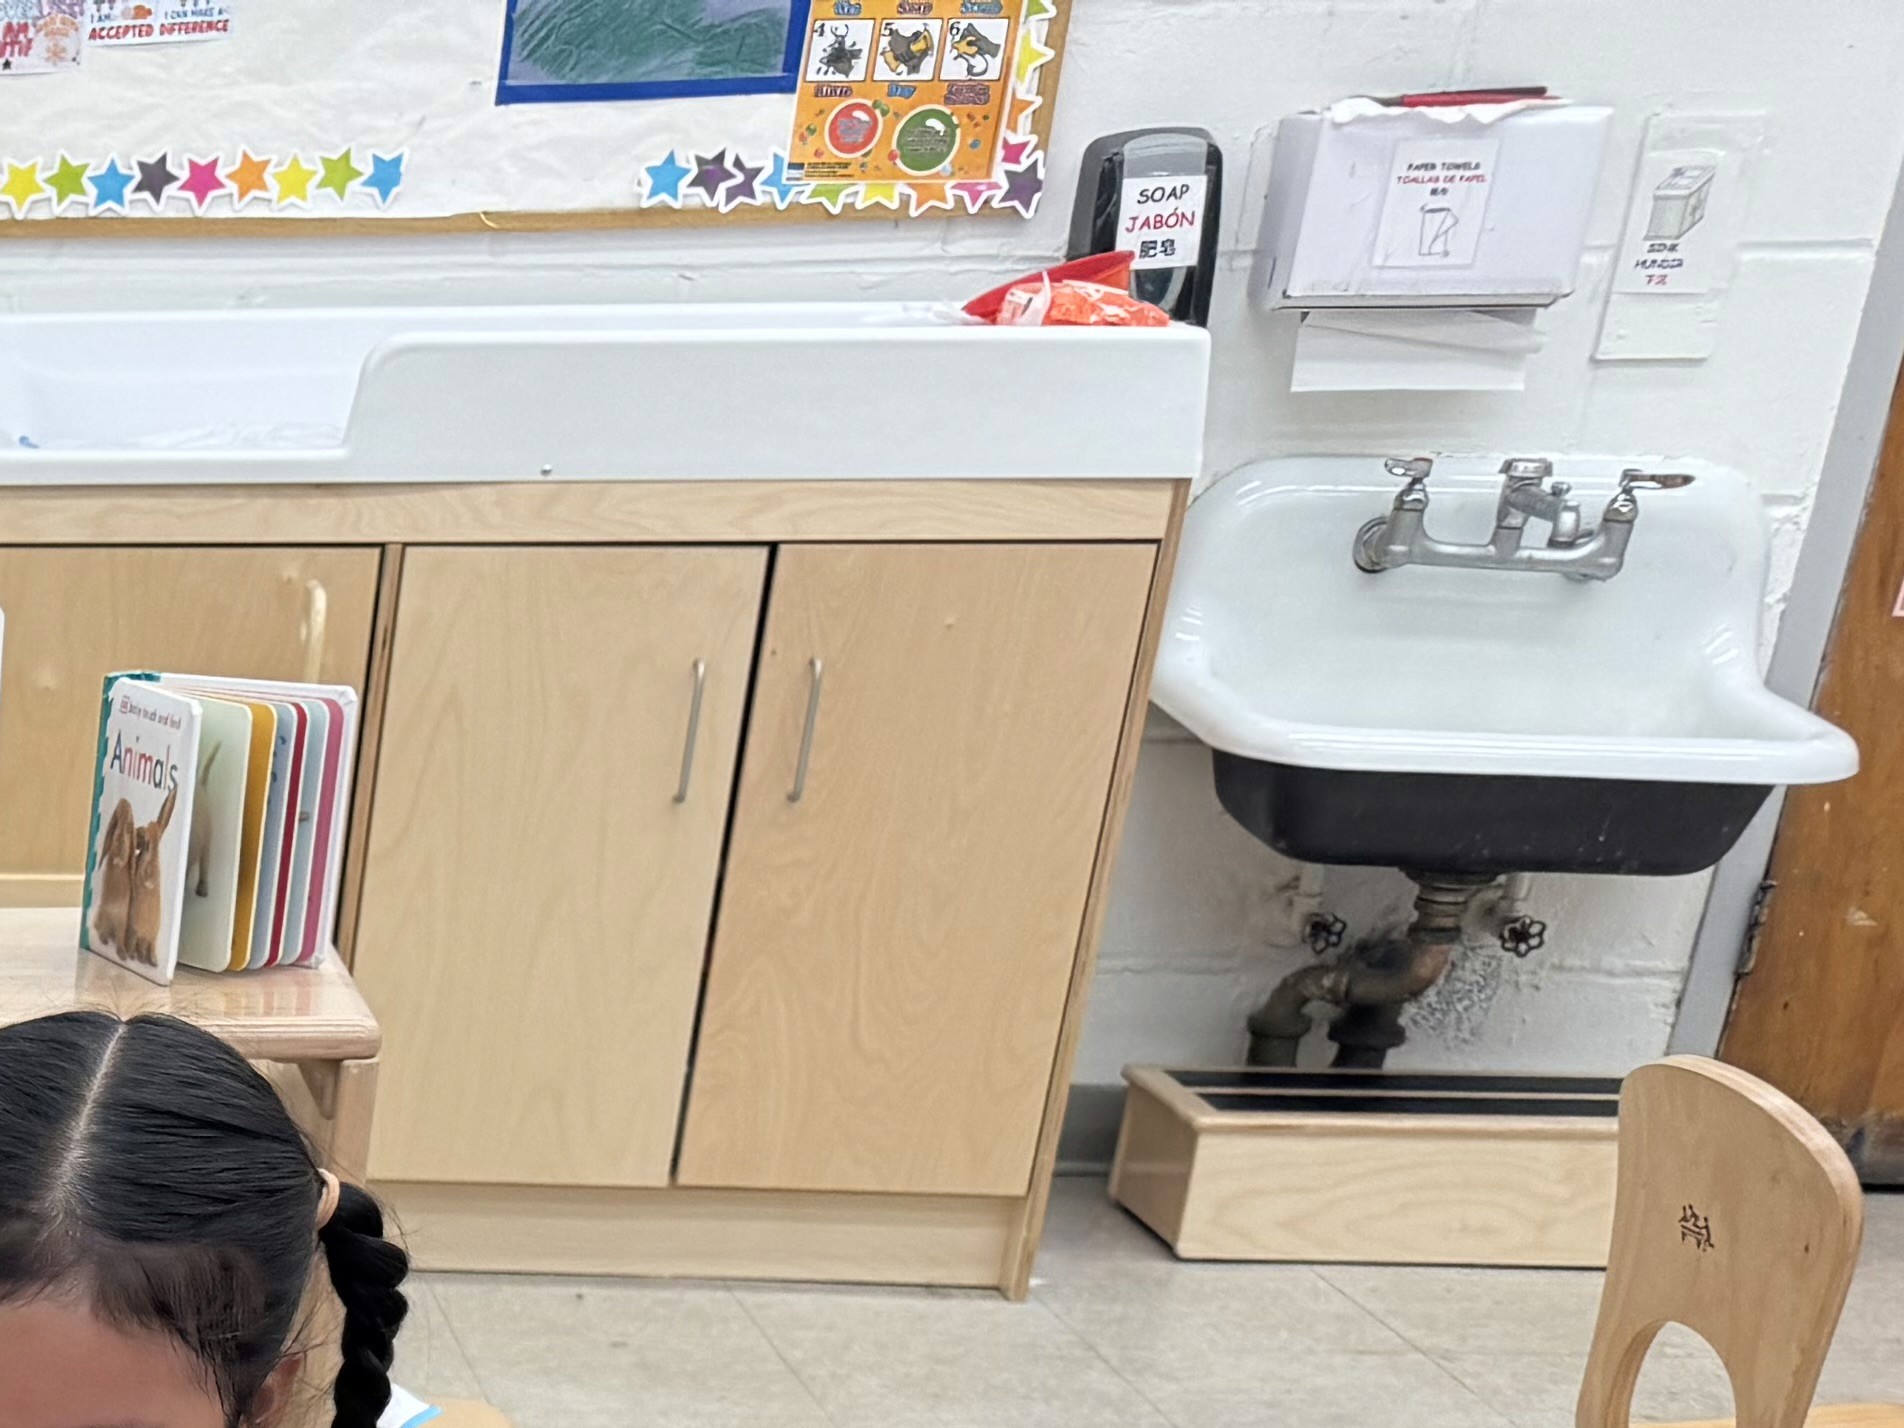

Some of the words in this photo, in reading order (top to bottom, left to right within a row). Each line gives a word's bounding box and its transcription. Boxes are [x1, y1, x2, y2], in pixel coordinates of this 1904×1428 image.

[949, 22, 961, 36] 6
[1137, 184, 1190, 204] SOAP
[1125, 206, 1195, 233] JABÓN
[110, 729, 178, 795] Animals
